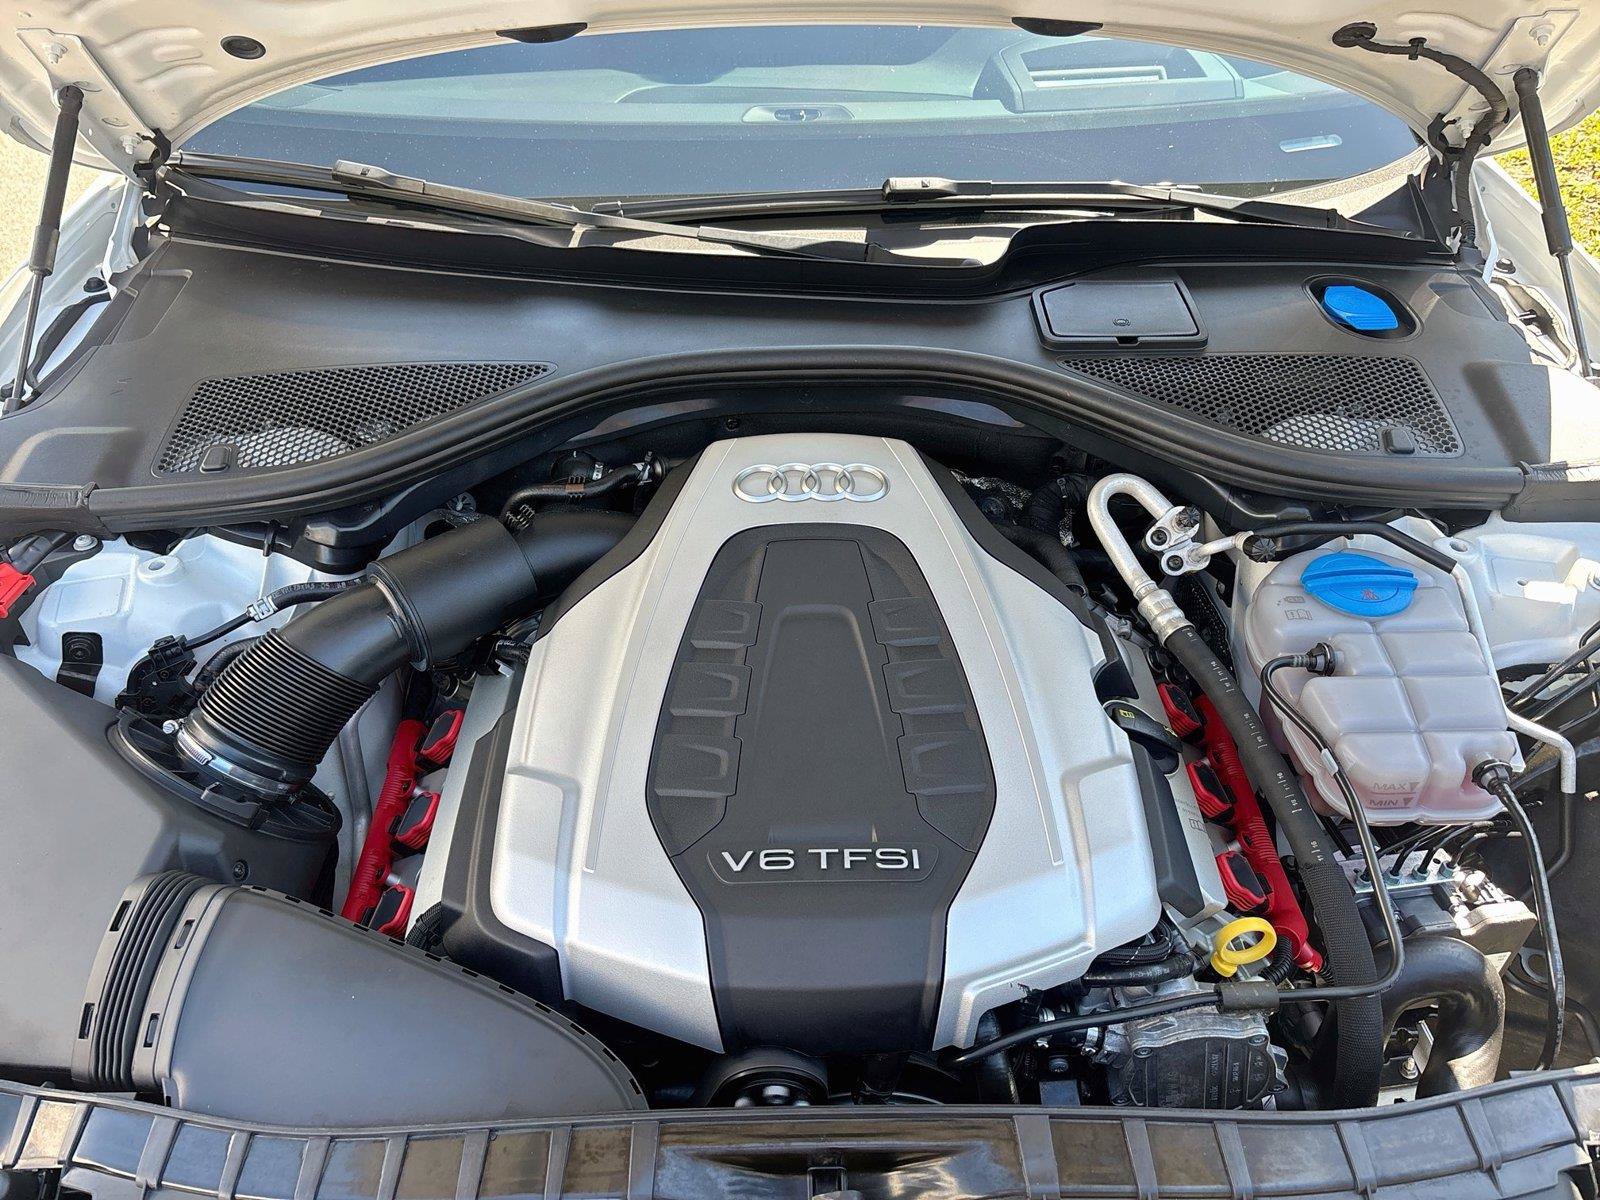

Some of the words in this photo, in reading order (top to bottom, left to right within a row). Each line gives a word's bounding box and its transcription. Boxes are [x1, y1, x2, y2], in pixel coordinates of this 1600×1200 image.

[1373, 782, 1407, 791] MAX
[1369, 799, 1399, 807] MIN
[721, 848, 795, 872] V6
[807, 848, 921, 870] TFSI
